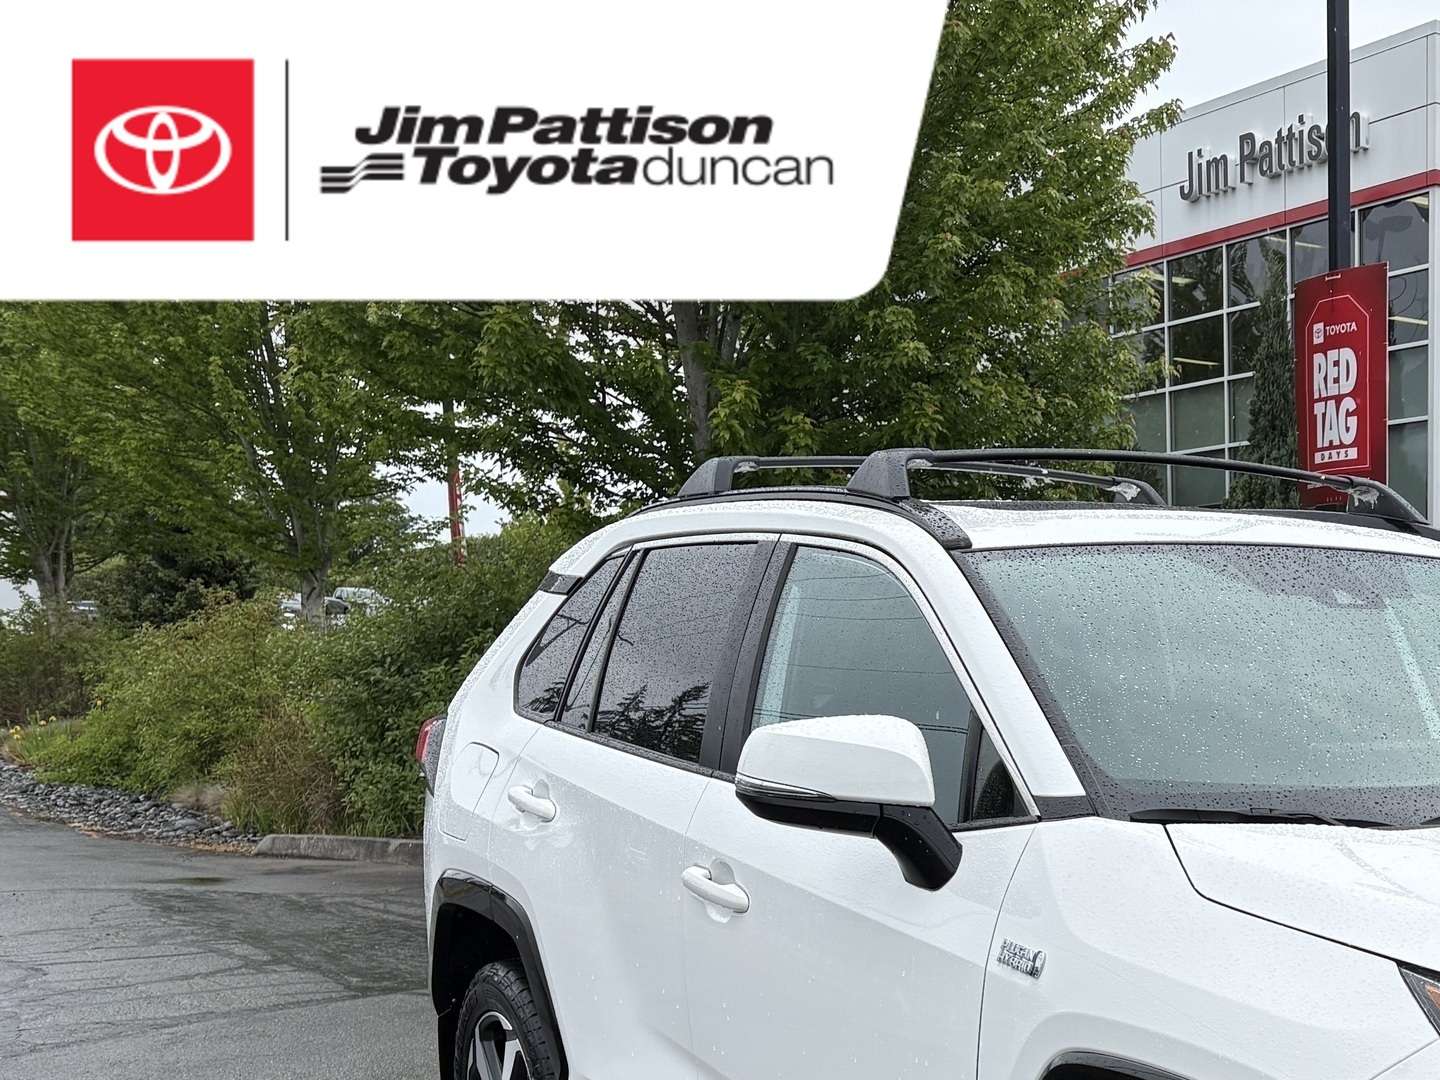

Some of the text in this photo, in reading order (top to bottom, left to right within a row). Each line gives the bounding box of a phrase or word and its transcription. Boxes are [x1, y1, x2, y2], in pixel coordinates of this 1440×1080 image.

[1180, 111, 1362, 201] Jim Pattisn
[1325, 321, 1358, 336] TOYOTA
[1313, 348, 1358, 399] RED
[1314, 396, 1358, 448] TAG
[1320, 450, 1349, 462] DAYS
